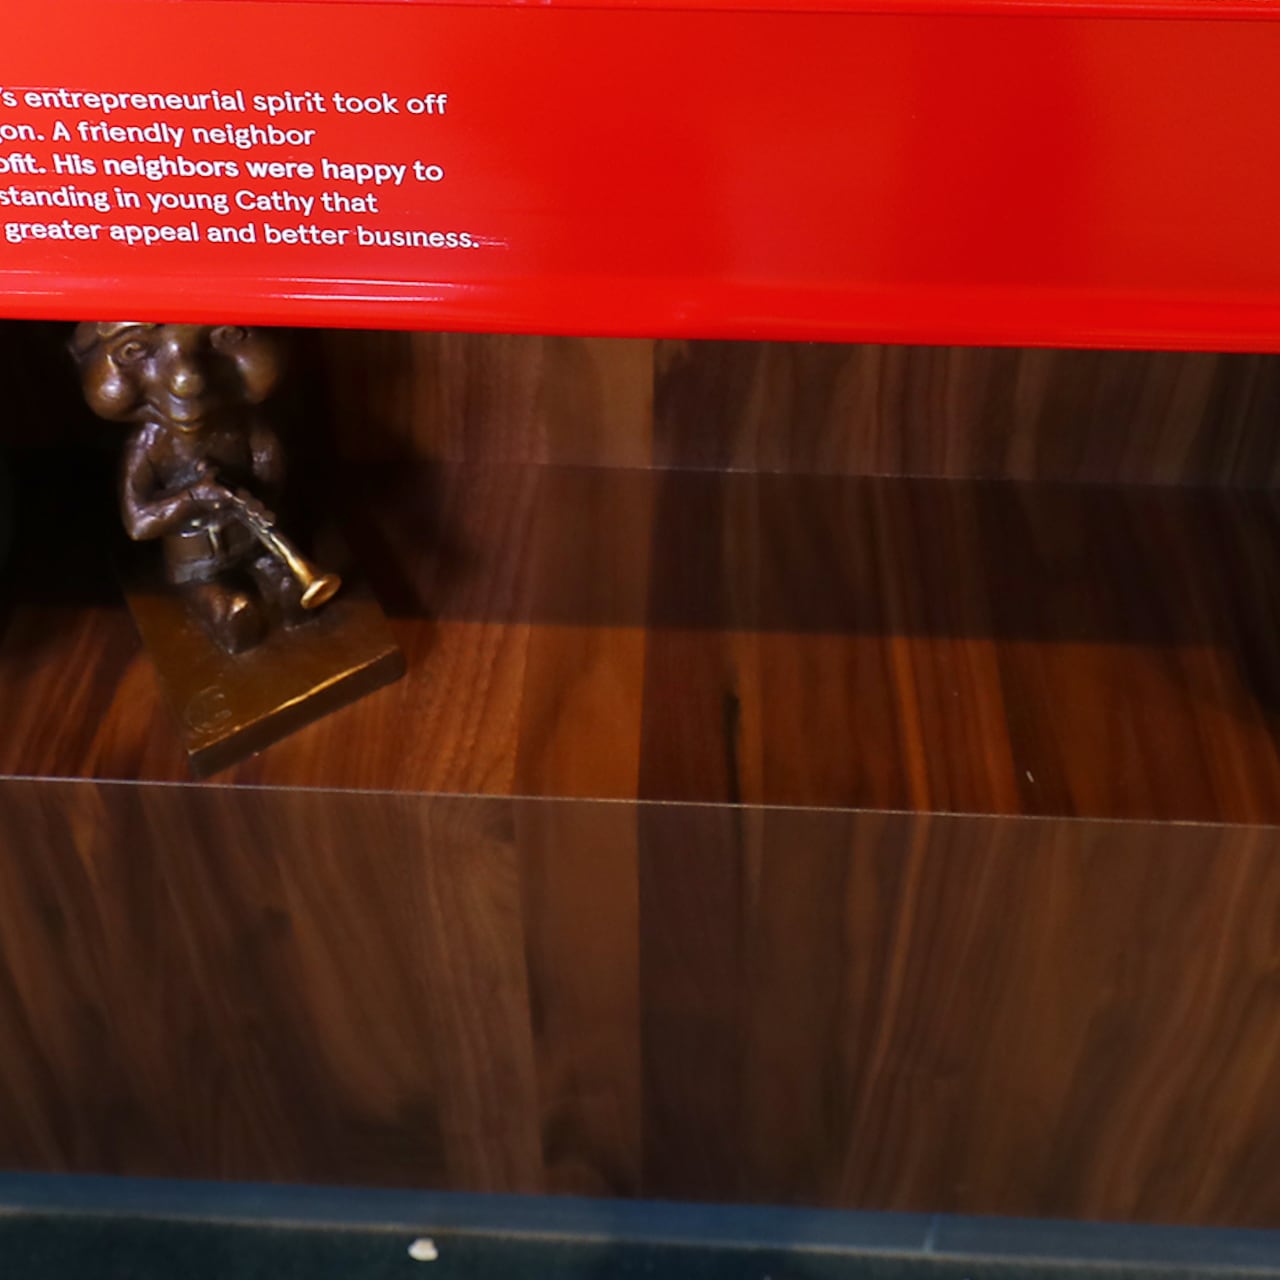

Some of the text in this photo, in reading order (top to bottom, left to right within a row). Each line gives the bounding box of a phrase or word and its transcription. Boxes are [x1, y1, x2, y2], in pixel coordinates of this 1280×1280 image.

[24, 89, 245, 114] entrepreneurial
[253, 92, 326, 116] spirit
[333, 93, 399, 114] took
[407, 94, 447, 115] off
[53, 122, 70, 142] A
[77, 122, 184, 148] friendly
[192, 124, 316, 148] neighbor
[53, 154, 96, 175] His
[104, 155, 240, 180] neighbors
[246, 162, 314, 179] were
[322, 159, 407, 185] happy
[413, 161, 444, 181] to
[114, 188, 140, 207] in
[147, 193, 229, 214] young
[236, 191, 314, 216] Cathy
[321, 192, 378, 212] that
[5, 220, 102, 243] greater
[110, 222, 200, 245] appeal
[208, 223, 256, 242] and
[264, 224, 350, 245] better
[357, 226, 480, 248] business.
